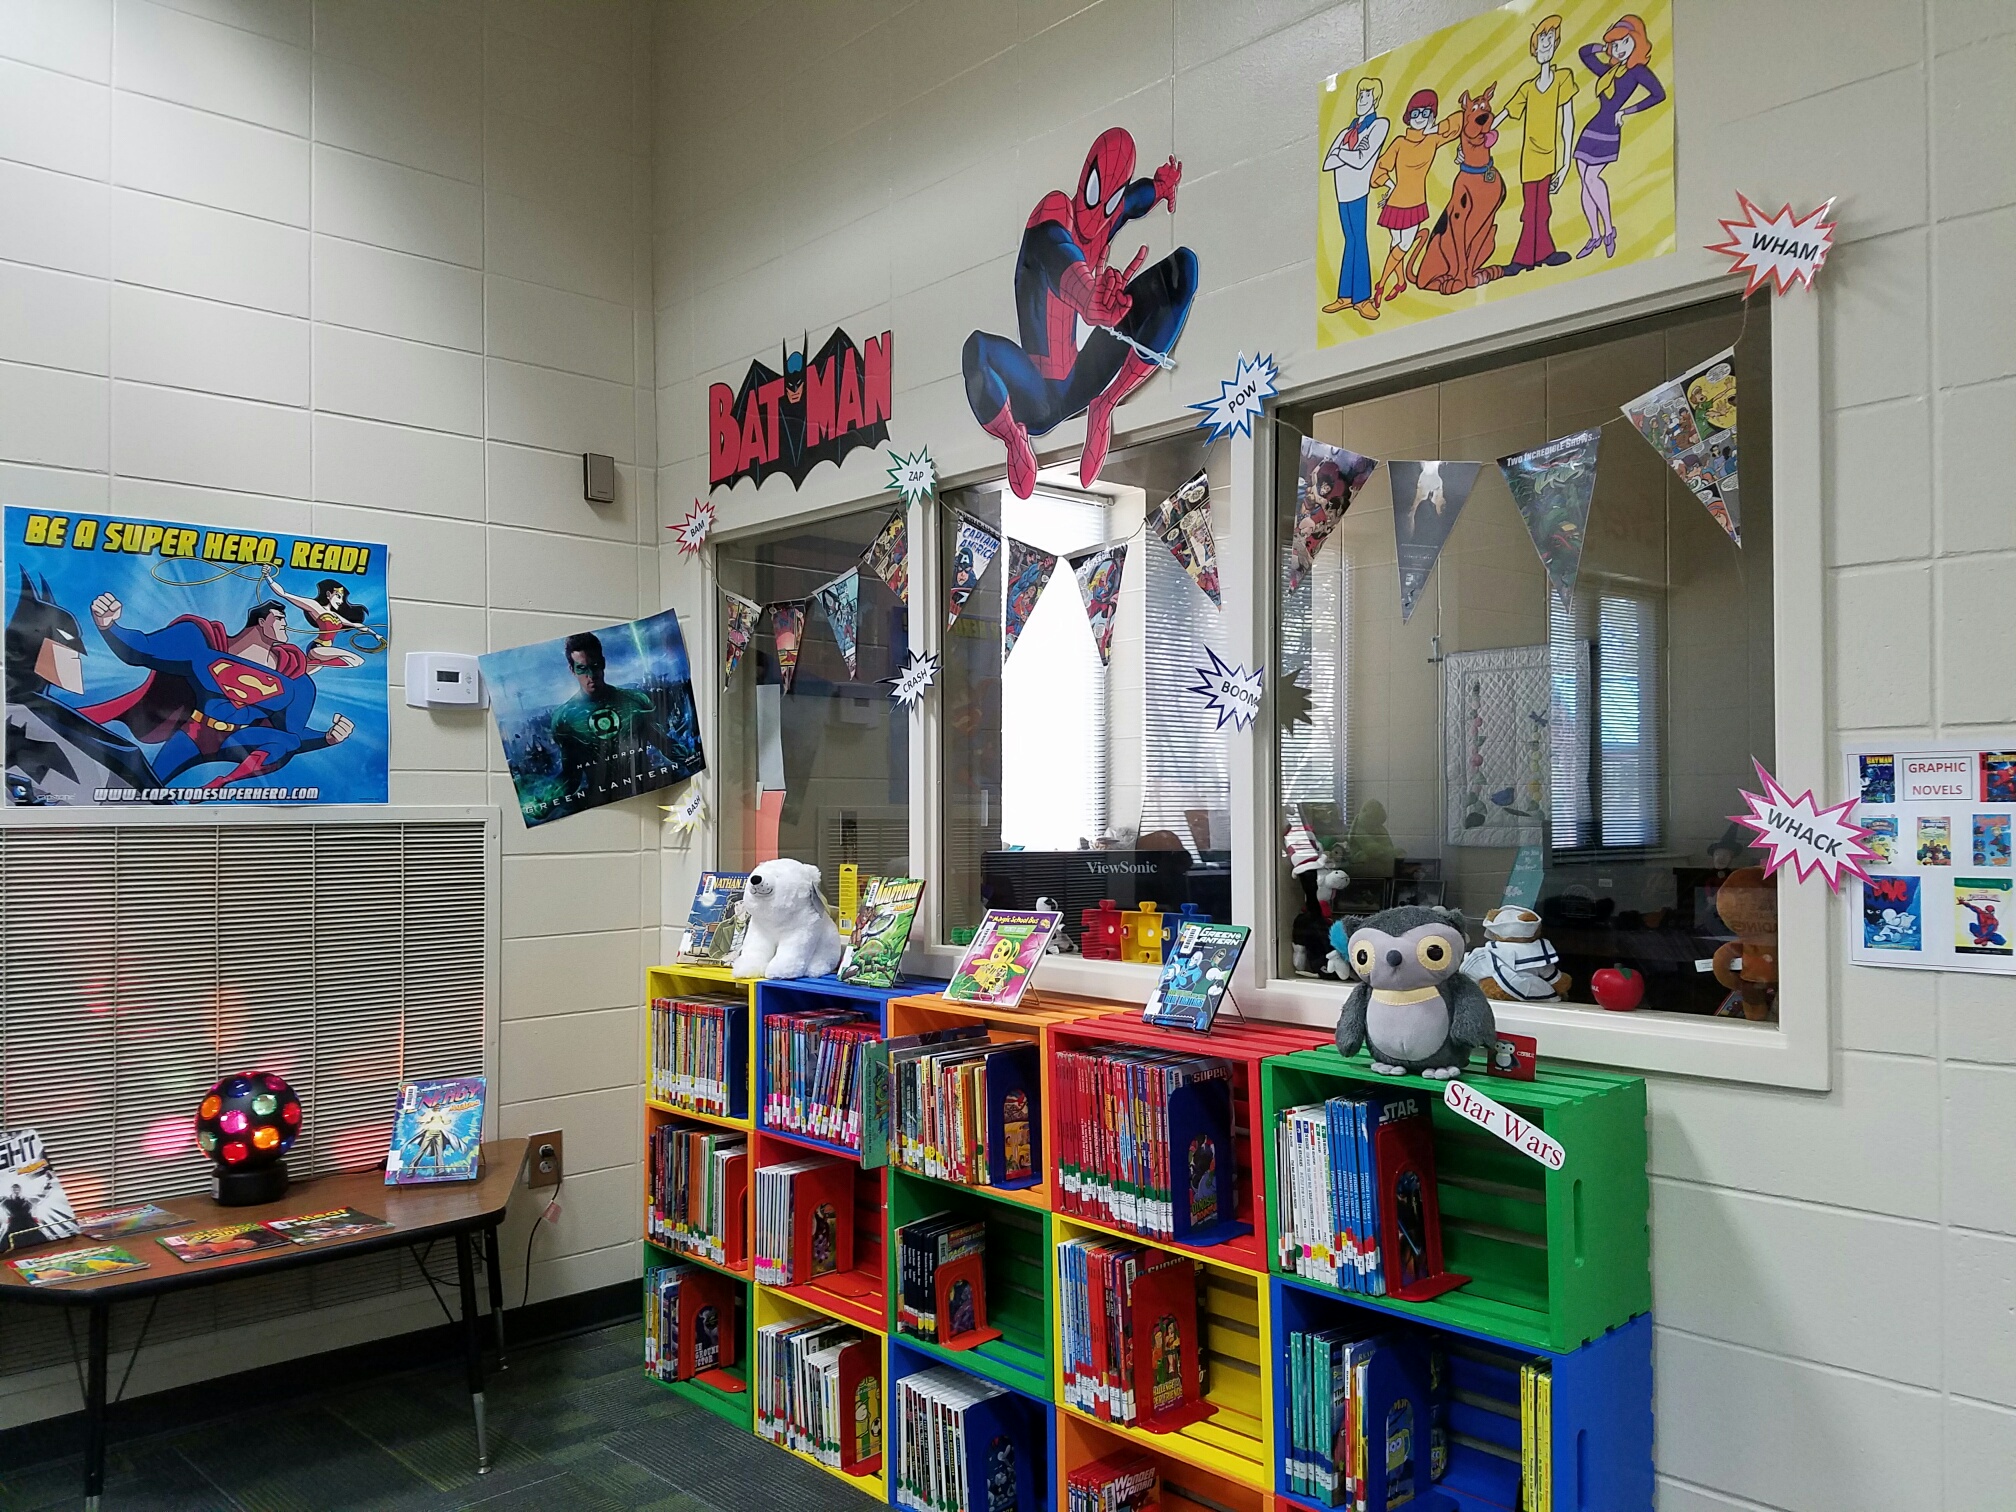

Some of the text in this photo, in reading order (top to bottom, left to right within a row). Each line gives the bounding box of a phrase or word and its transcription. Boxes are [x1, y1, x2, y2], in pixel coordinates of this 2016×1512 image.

[1751, 232, 1819, 261] WHAM
[1228, 380, 1258, 413] POW
[1507, 456, 1523, 467] TWO
[1524, 441, 1566, 461] INCREDIBLE
[908, 470, 924, 482] ZAP
[690, 519, 705, 537] BAM
[962, 528, 1000, 549] CAPTAIN
[25, 515, 370, 574] BE A SUPER HERO. READ!
[960, 540, 995, 559] AMERICA
[902, 669, 927, 693] CRASH
[576, 745, 652, 770] HAL JORDAN
[1908, 762, 1967, 773] GRAPHIC
[525, 763, 679, 814] GREEN LANTERN
[1912, 785, 1963, 796] NOVELS
[686, 795, 701, 816] BASH
[1767, 808, 1842, 858] WHACK
[1086, 861, 1158, 875] ViewSonic
[1196, 936, 1240, 946] ANTERN
[1200, 926, 1236, 939] GREEN
[1193, 1066, 1227, 1083] SUPER
[412, 1084, 480, 1111] NERGY
[1379, 1099, 1419, 1122] STAR
[1446, 1083, 1564, 1168] Star Wars
[298, 1208, 347, 1221] Heat
[1117, 1478, 1153, 1503] WOMAN
